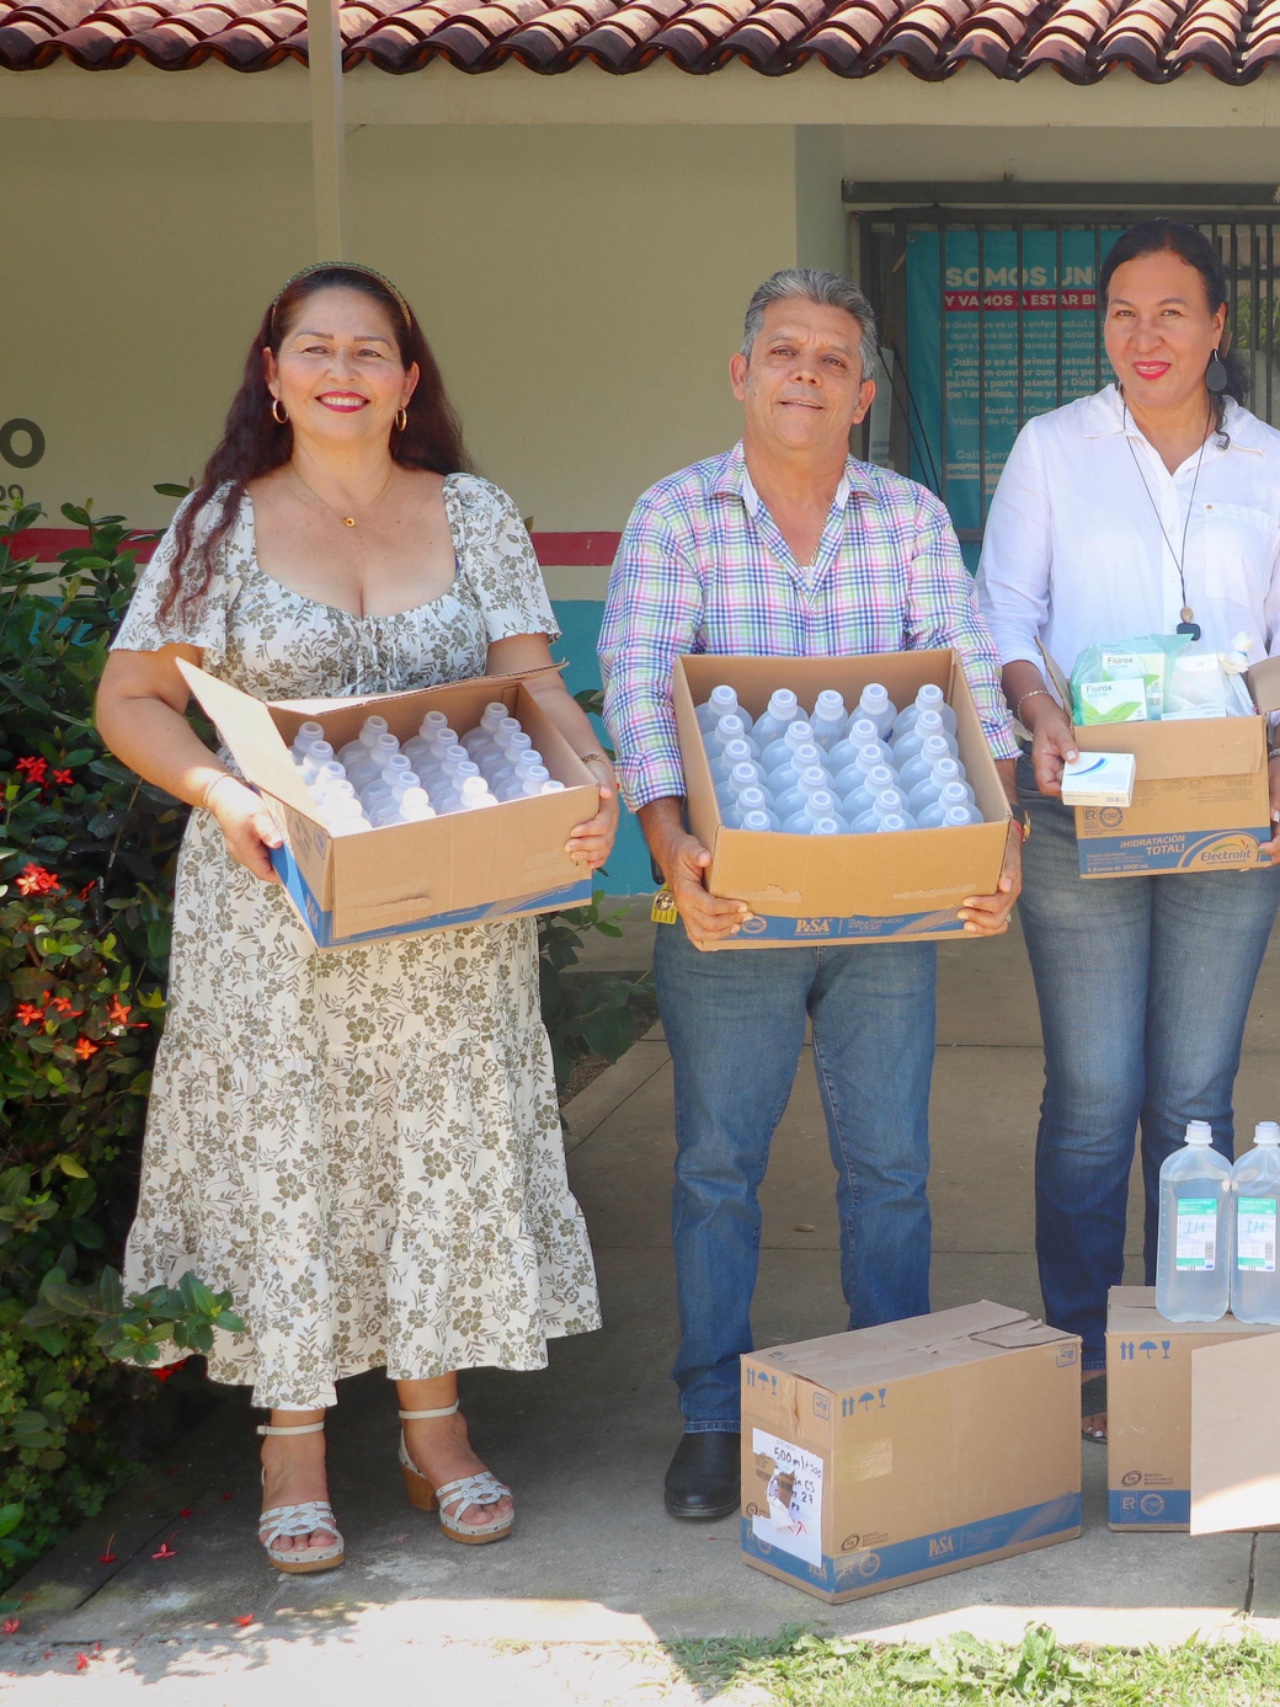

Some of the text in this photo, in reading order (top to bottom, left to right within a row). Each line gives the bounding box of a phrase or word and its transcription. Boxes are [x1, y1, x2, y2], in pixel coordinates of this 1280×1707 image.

[945, 266, 1096, 287] SOMOS UN
[945, 296, 954, 306] Y
[958, 295, 1013, 306] VAMOS
[1030, 294, 1078, 305] ESTAR
[945, 344, 974, 352] angre
[953, 358, 992, 366] Jaliso
[946, 379, 987, 389] públic
[1024, 379, 1069, 387] atendr
[1146, 843, 1186, 856] TOTAL!
[1201, 843, 1253, 862] Electrolit
[1122, 1497, 1136, 1511] ER
